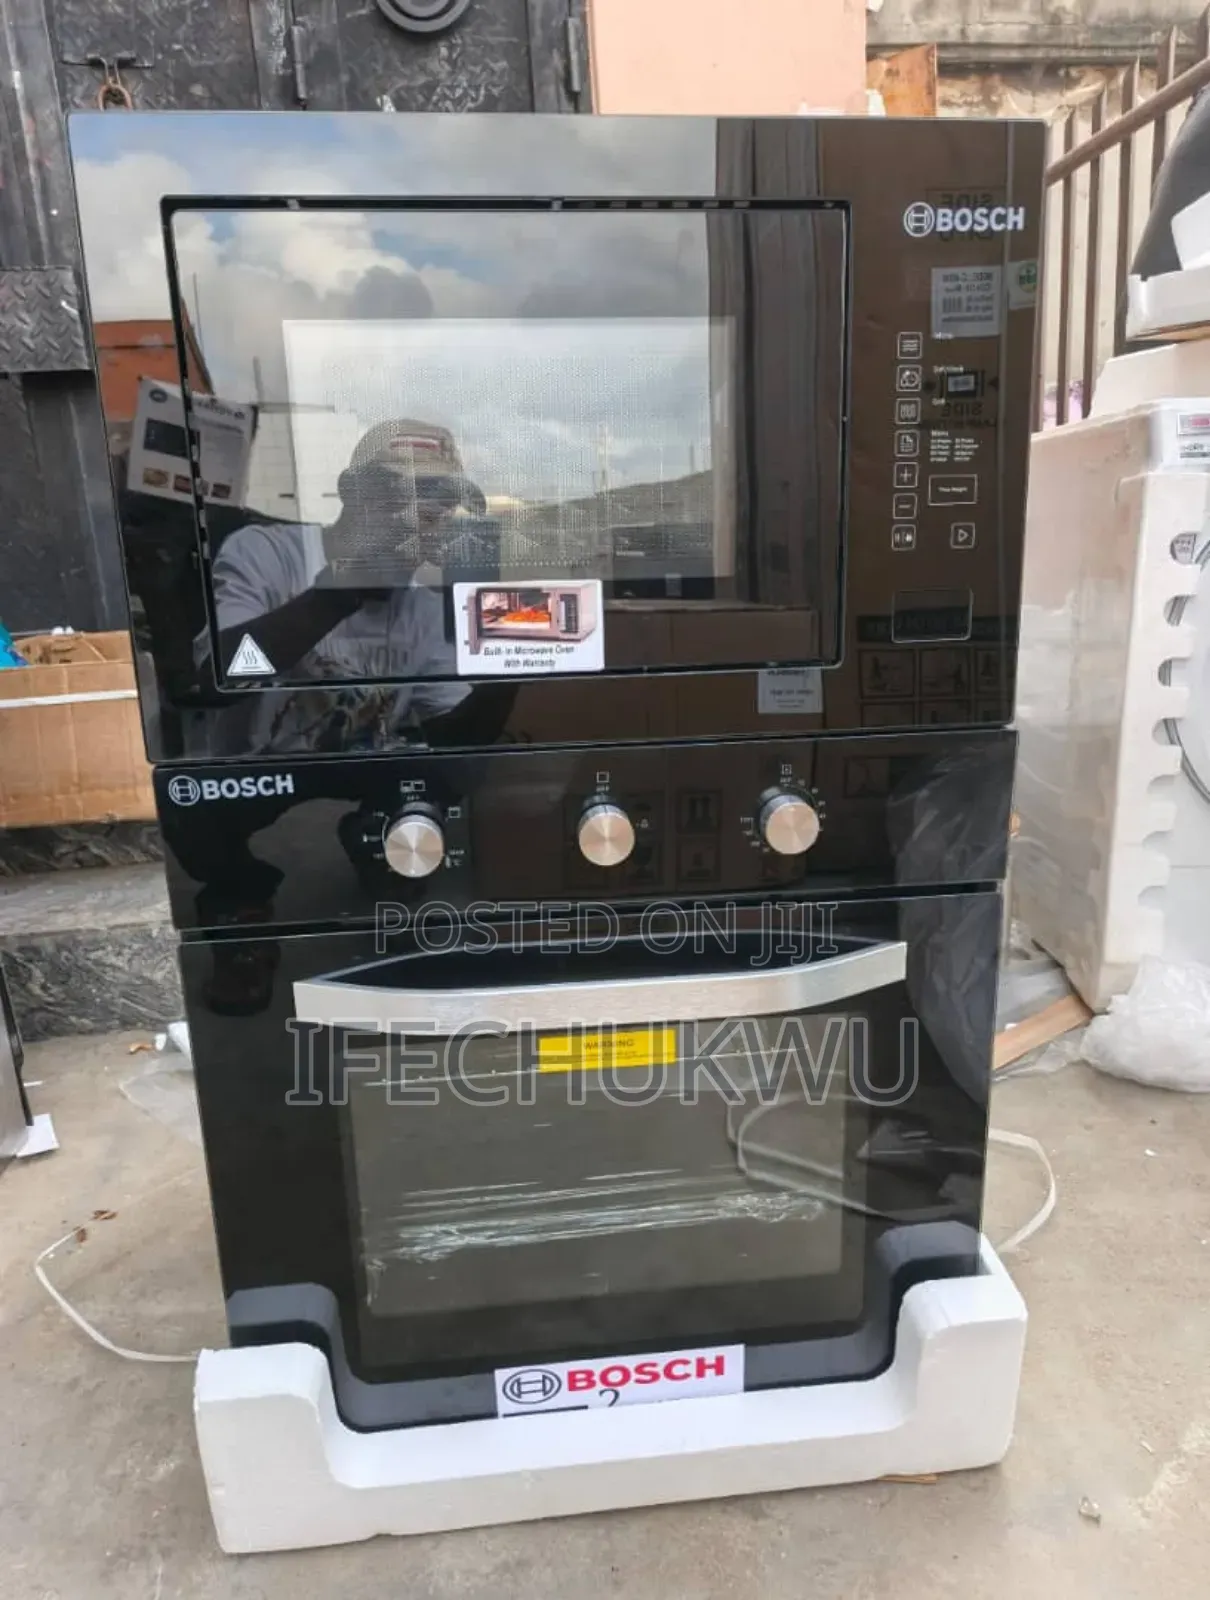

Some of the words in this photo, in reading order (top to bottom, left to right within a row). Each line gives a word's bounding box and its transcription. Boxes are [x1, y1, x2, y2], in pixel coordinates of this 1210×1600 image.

[936, 206, 1025, 232] BOSCH
[514, 645, 554, 656] Microwave
[555, 644, 574, 654] Oven
[504, 659, 521, 668] With
[523, 658, 556, 668] Warranty
[201, 774, 294, 800] BOSCH
[584, 1038, 635, 1049] WARNING
[567, 1355, 725, 1392] BOSCH
